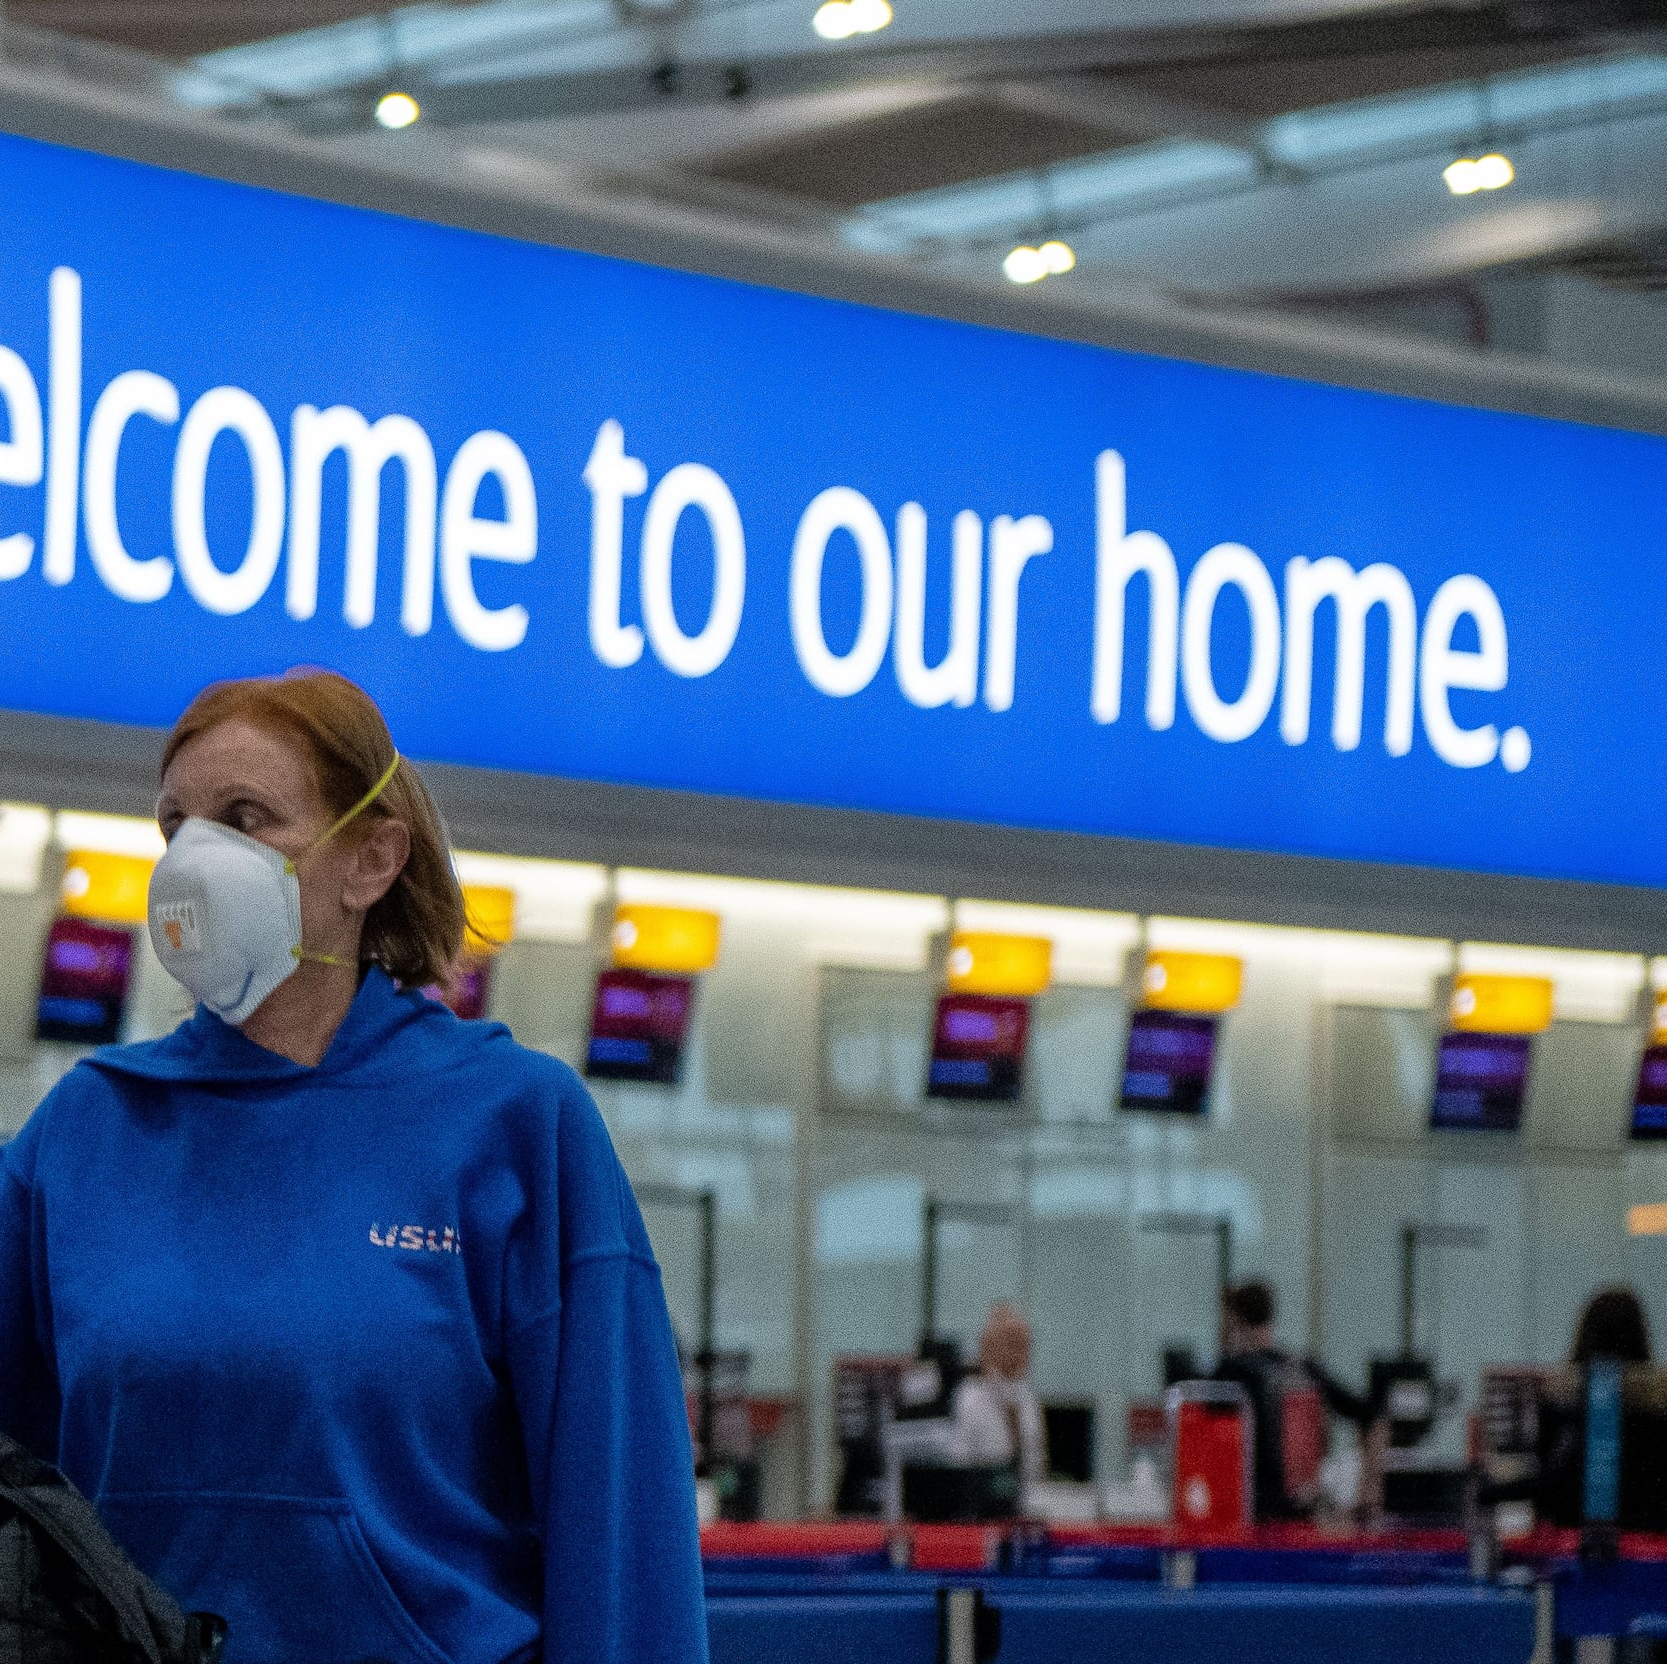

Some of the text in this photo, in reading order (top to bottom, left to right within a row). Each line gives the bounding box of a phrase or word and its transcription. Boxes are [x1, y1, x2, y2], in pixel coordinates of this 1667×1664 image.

[582, 419, 747, 678] to
[789, 485, 1054, 712] our
[1091, 449, 1532, 773] home.
